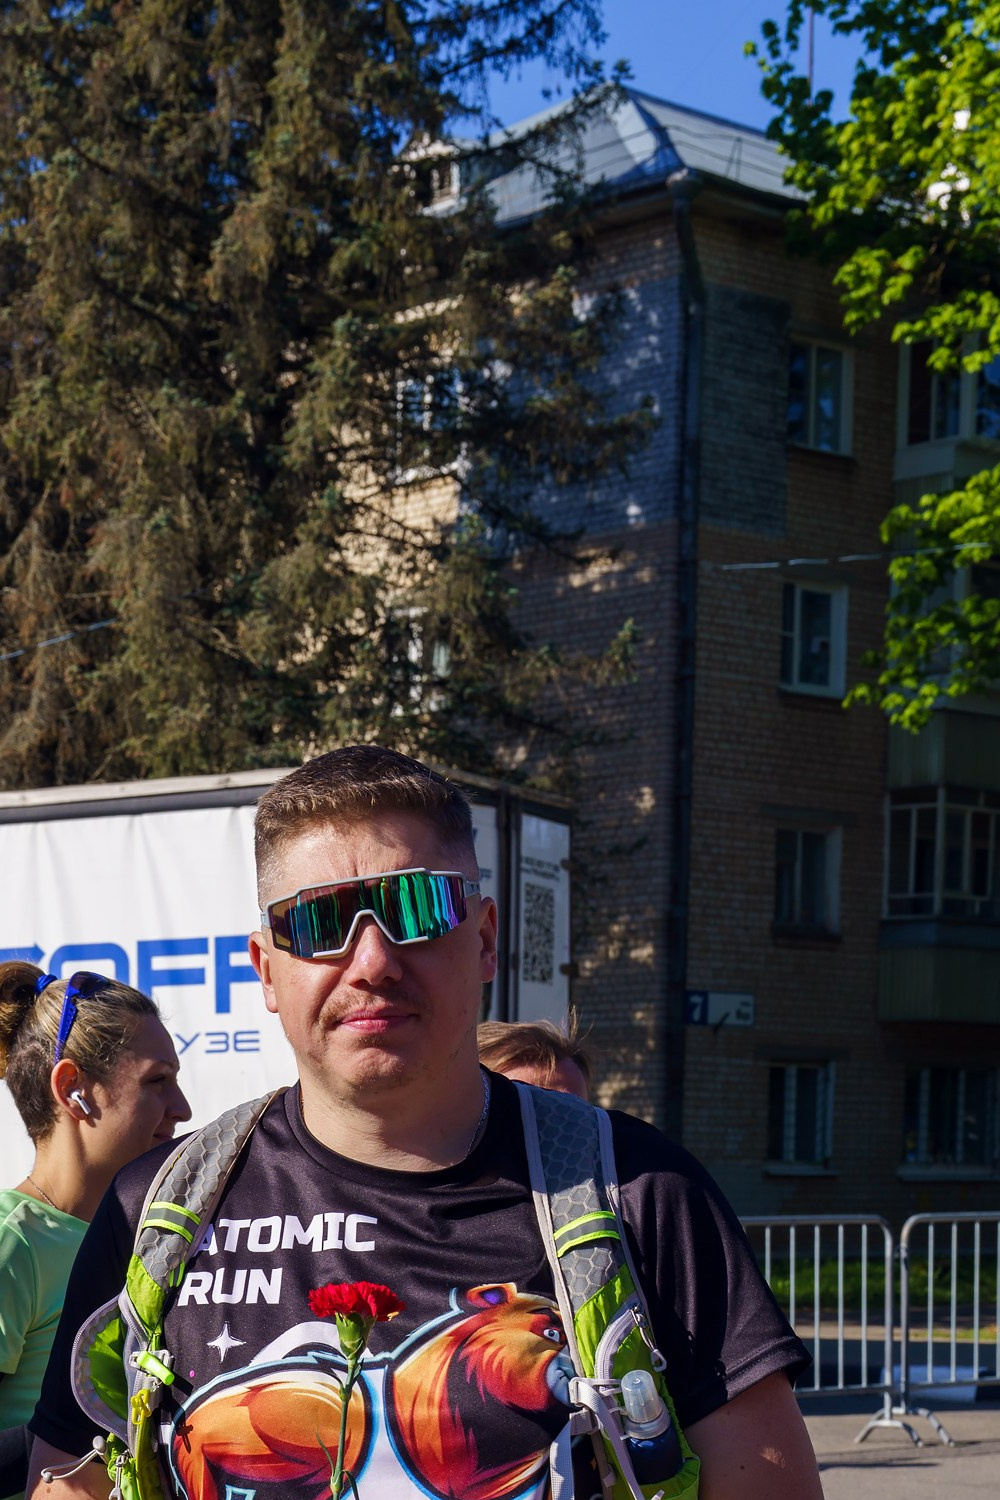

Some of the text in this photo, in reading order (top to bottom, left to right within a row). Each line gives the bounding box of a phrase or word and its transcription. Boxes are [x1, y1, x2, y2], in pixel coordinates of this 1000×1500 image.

[175, 1030, 260, 1055] УЗЕ
[194, 1212, 378, 1257] ATOMIC
[177, 1267, 283, 1307] RUN
